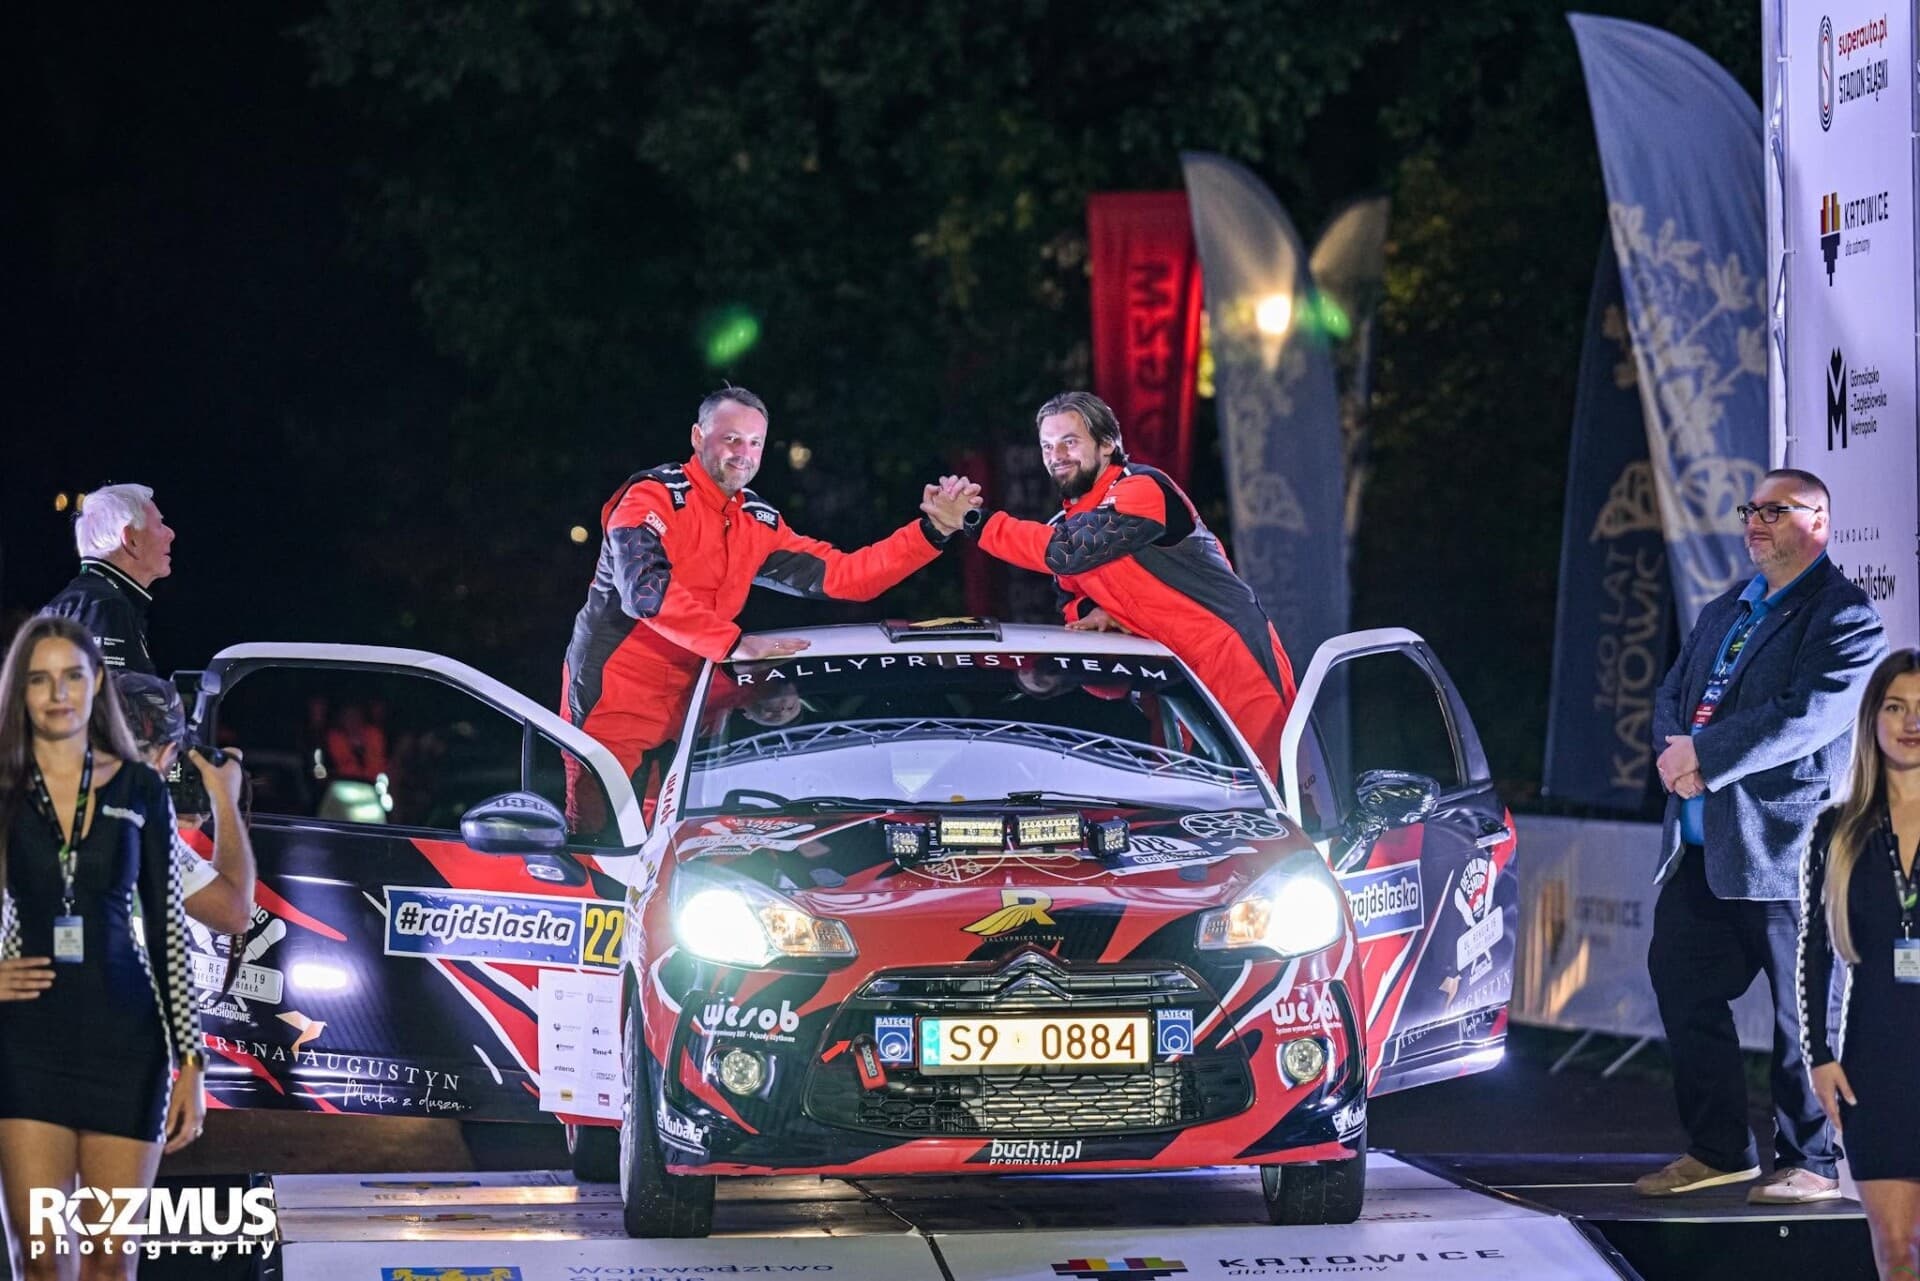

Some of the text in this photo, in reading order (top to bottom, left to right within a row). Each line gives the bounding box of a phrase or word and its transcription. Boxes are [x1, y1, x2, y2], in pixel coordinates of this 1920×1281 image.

[1838, 12, 1887, 60] superauto.pl
[1839, 67, 1866, 104] STADION
[1844, 191, 1889, 231] KATOWICE
[1834, 527, 1880, 544] FUNDACJA
[737, 655, 1168, 686] RALLYPRIEST TEAM
[400, 906, 571, 941] #rajdslaska
[253, 972, 266, 985] 19
[703, 1000, 800, 1033] wesob
[875, 1015, 913, 1026] BATECH
[1157, 1009, 1193, 1019] BATECH
[950, 1023, 1136, 1061] S9 0884
[201, 1032, 461, 1091] IRENA AUGUSTYN
[402, 1097, 412, 1107] z
[989, 1158, 1058, 1167] promotion
[991, 1138, 1082, 1163] buchti.pl
[1218, 1249, 1505, 1268] KATOWICE
[1228, 1265, 1389, 1276] dla odmiany
